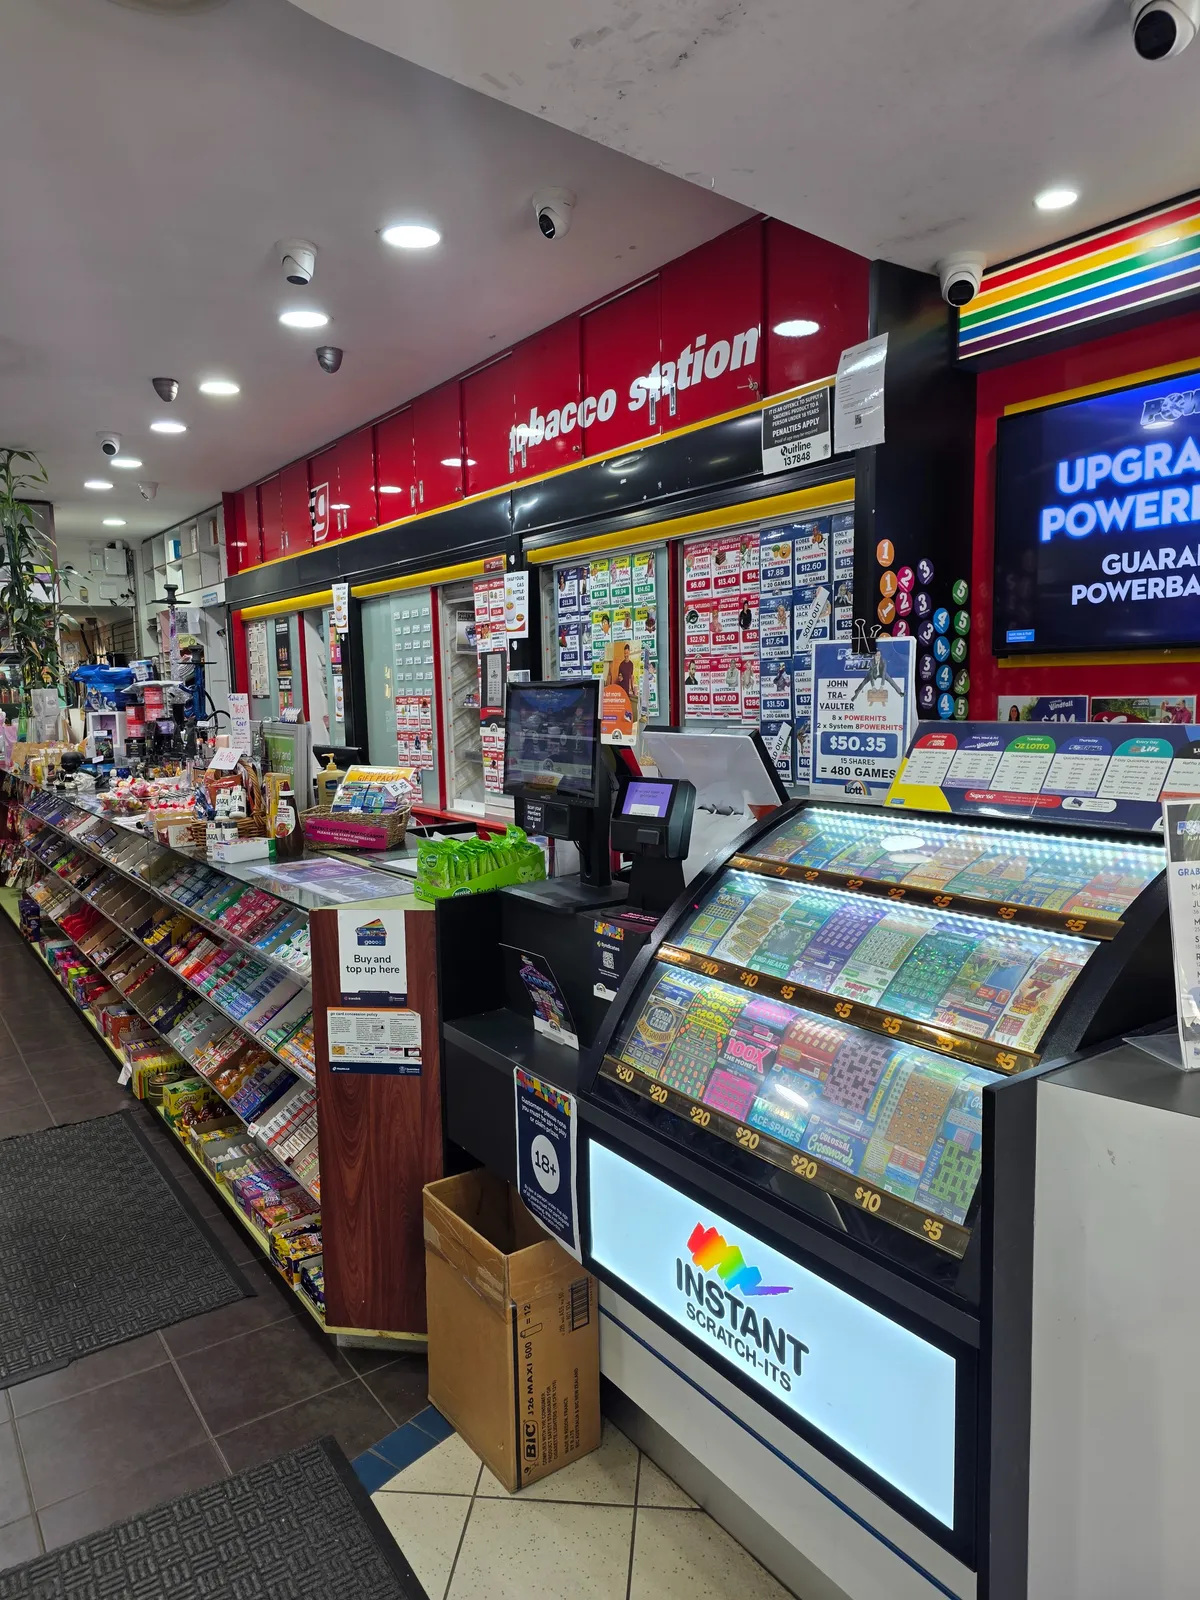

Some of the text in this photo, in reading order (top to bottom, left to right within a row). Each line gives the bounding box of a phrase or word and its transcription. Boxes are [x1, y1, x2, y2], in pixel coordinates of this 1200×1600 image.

[509, 389, 617, 455] tobacco
[628, 326, 760, 411] station
[782, 401, 799, 411] OFFENCE
[804, 395, 819, 405] SUPPLY
[772, 408, 820, 427] PERSON UNDER YEARS
[773, 411, 791, 420] SMOKING
[791, 406, 810, 416] PRODUCT
[772, 417, 820, 438] PENALTIES APPLY
[1041, 485, 1200, 542] POWER
[802, 552, 827, 560] POWERHITS
[882, 541, 890, 560] 1
[801, 562, 822, 572] $12.60
[1102, 543, 1200, 576] GUARA
[767, 568, 785, 577] $7.88
[900, 569, 913, 587] 2
[919, 560, 931, 579] 3
[808, 575, 826, 583] GAMES
[885, 573, 892, 592] 1
[957, 580, 968, 598] 5
[899, 592, 909, 610] 2
[918, 593, 927, 611] 3
[803, 602, 822, 638] SOLD OUT
[938, 610, 948, 628] 4
[959, 612, 969, 629] 5
[924, 623, 934, 640] 3
[765, 637, 784, 646] $17.64
[956, 638, 966, 656] 5
[923, 656, 931, 671] 3
[941, 666, 949, 682] 4
[827, 680, 848, 688] JOHN
[828, 691, 847, 699] TRA-
[925, 685, 933, 704] 3
[940, 694, 950, 711] 4
[766, 700, 785, 708] $31.50
[819, 702, 855, 711] VAULTER
[957, 699, 965, 716] 5
[829, 722, 854, 731] System
[844, 714, 887, 722] POWERHITS
[830, 735, 887, 753] $50.35
[849, 758, 876, 766] SHARES
[830, 765, 896, 779] 480 GAMES
[804, 871, 820, 882] $2
[846, 879, 864, 890] $2
[887, 888, 906, 899] $2
[933, 894, 953, 908] $5
[997, 906, 1018, 920] $5
[1065, 919, 1087, 933] $5
[354, 954, 392, 965] Buy and
[770, 959, 790, 971] HEARTS
[345, 965, 400, 975] top up here
[701, 961, 719, 976] $10
[740, 971, 759, 988] $10
[780, 985, 796, 1000] $5
[654, 1008, 673, 1021] MEGA
[834, 1002, 854, 1019] $5
[650, 1016, 669, 1032] CASH
[882, 1015, 903, 1035] $5
[723, 1053, 757, 1071] THE MONEY
[726, 1038, 772, 1074] 100X
[995, 1051, 1018, 1071] $5
[616, 1064, 634, 1083] $30
[649, 1084, 669, 1104] $20
[690, 1105, 711, 1127] $20
[752, 1113, 801, 1143] ACE SPADES
[735, 1126, 760, 1150] $20
[819, 1131, 851, 1152] COLOSSAL
[807, 1133, 855, 1167] Crosswords
[534, 1149, 557, 1177] 18+
[791, 1154, 818, 1179] $20
[854, 1186, 882, 1213] $10
[923, 1218, 944, 1241] $5
[524, 1303, 532, 1317] 12
[676, 1257, 810, 1377] INSTANT
[524, 1341, 533, 1360] 600
[686, 1302, 792, 1392] SCRATCH-ITS
[526, 1363, 534, 1394] MAXI
[525, 1423, 537, 1458] BIC
